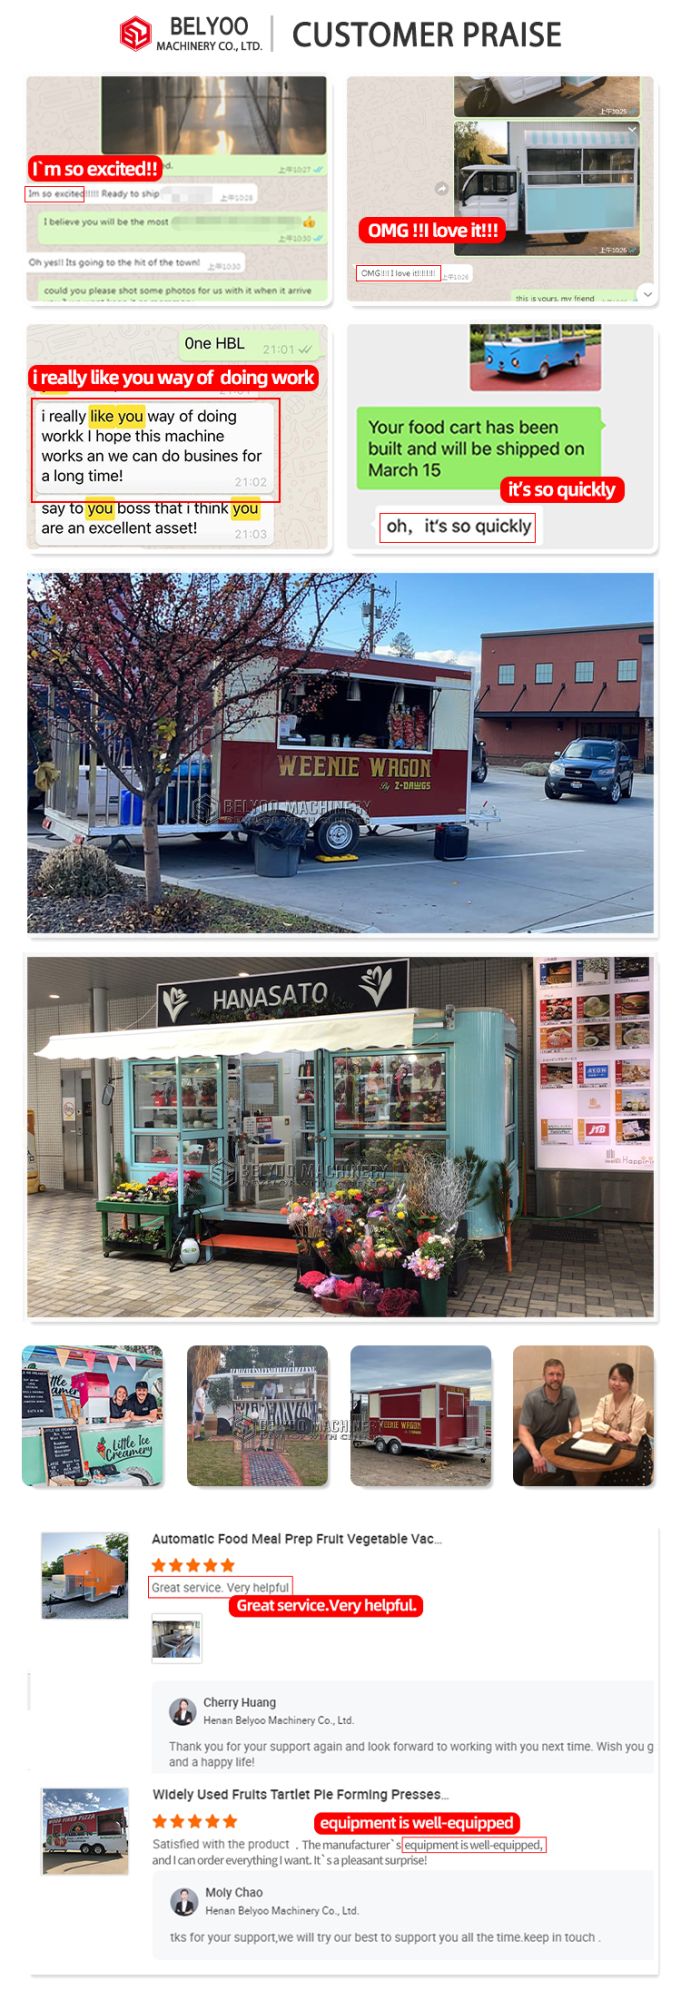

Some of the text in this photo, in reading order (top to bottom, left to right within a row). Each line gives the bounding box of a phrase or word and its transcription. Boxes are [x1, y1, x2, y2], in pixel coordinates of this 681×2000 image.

[102, 189, 160, 199] Ready ship
[50, 218, 80, 226] believe
[78, 260, 104, 268] going
[44, 287, 68, 295] could
[89, 287, 116, 296] please
[166, 287, 196, 296] photos
[216, 337, 244, 349] HBL
[264, 345, 294, 354] 21:01
[50, 410, 236, 425] really like doing
[368, 420, 558, 434] Your food cart has been
[42, 430, 83, 442] workk
[96, 430, 131, 444] hope
[166, 430, 224, 442] machine
[42, 449, 238, 462] works busines
[369, 441, 559, 458] built will shipped
[369, 463, 441, 477] March 15
[54, 469, 122, 485] long time!
[235, 477, 266, 488] 21:02
[117, 503, 228, 515] boss that think
[89, 522, 196, 534] excellent asset!
[476, 518, 532, 536] quickly
[235, 529, 267, 539] 21:03
[278, 755, 432, 778] WEENIE WAGON
[213, 982, 328, 1010] HANASATO
[112, 1434, 151, 1452] Little Ice
[105, 1445, 153, 1462] Creamery
[152, 1533, 408, 1546] Automatic Food Meal Prep Fruit Vegetable
[152, 1582, 288, 1594] Great service. Very helpful
[204, 1697, 276, 1710] Cherry Huang
[204, 1716, 315, 1726] Henan Belyoo Machinery
[169, 1742, 622, 1754] Thank your support again look forward working with next time. Wish
[201, 1757, 254, 1769] happy life!
[153, 1789, 194, 1802] Widely
[198, 1789, 228, 1800] Used
[233, 1789, 267, 1801] Fruits
[270, 1789, 310, 1801] Tartlet
[337, 1789, 387, 1802] Forming
[153, 1839, 289, 1851] Satisfied with product
[405, 1840, 542, 1852] equipment well-equipped,
[197, 1855, 427, 1867] order everything want. pleasant surprise!
[206, 1887, 263, 1900] Moly Chao
[206, 1906, 319, 1917] Henan Belyoo Machinery
[170, 1932, 186, 1942] tks
[208, 1934, 231, 1944] your
[296, 1933, 314, 1942] will
[355, 1933, 378, 1942] best
[395, 1934, 436, 1944] support
[565, 1933, 595, 1942] touch
